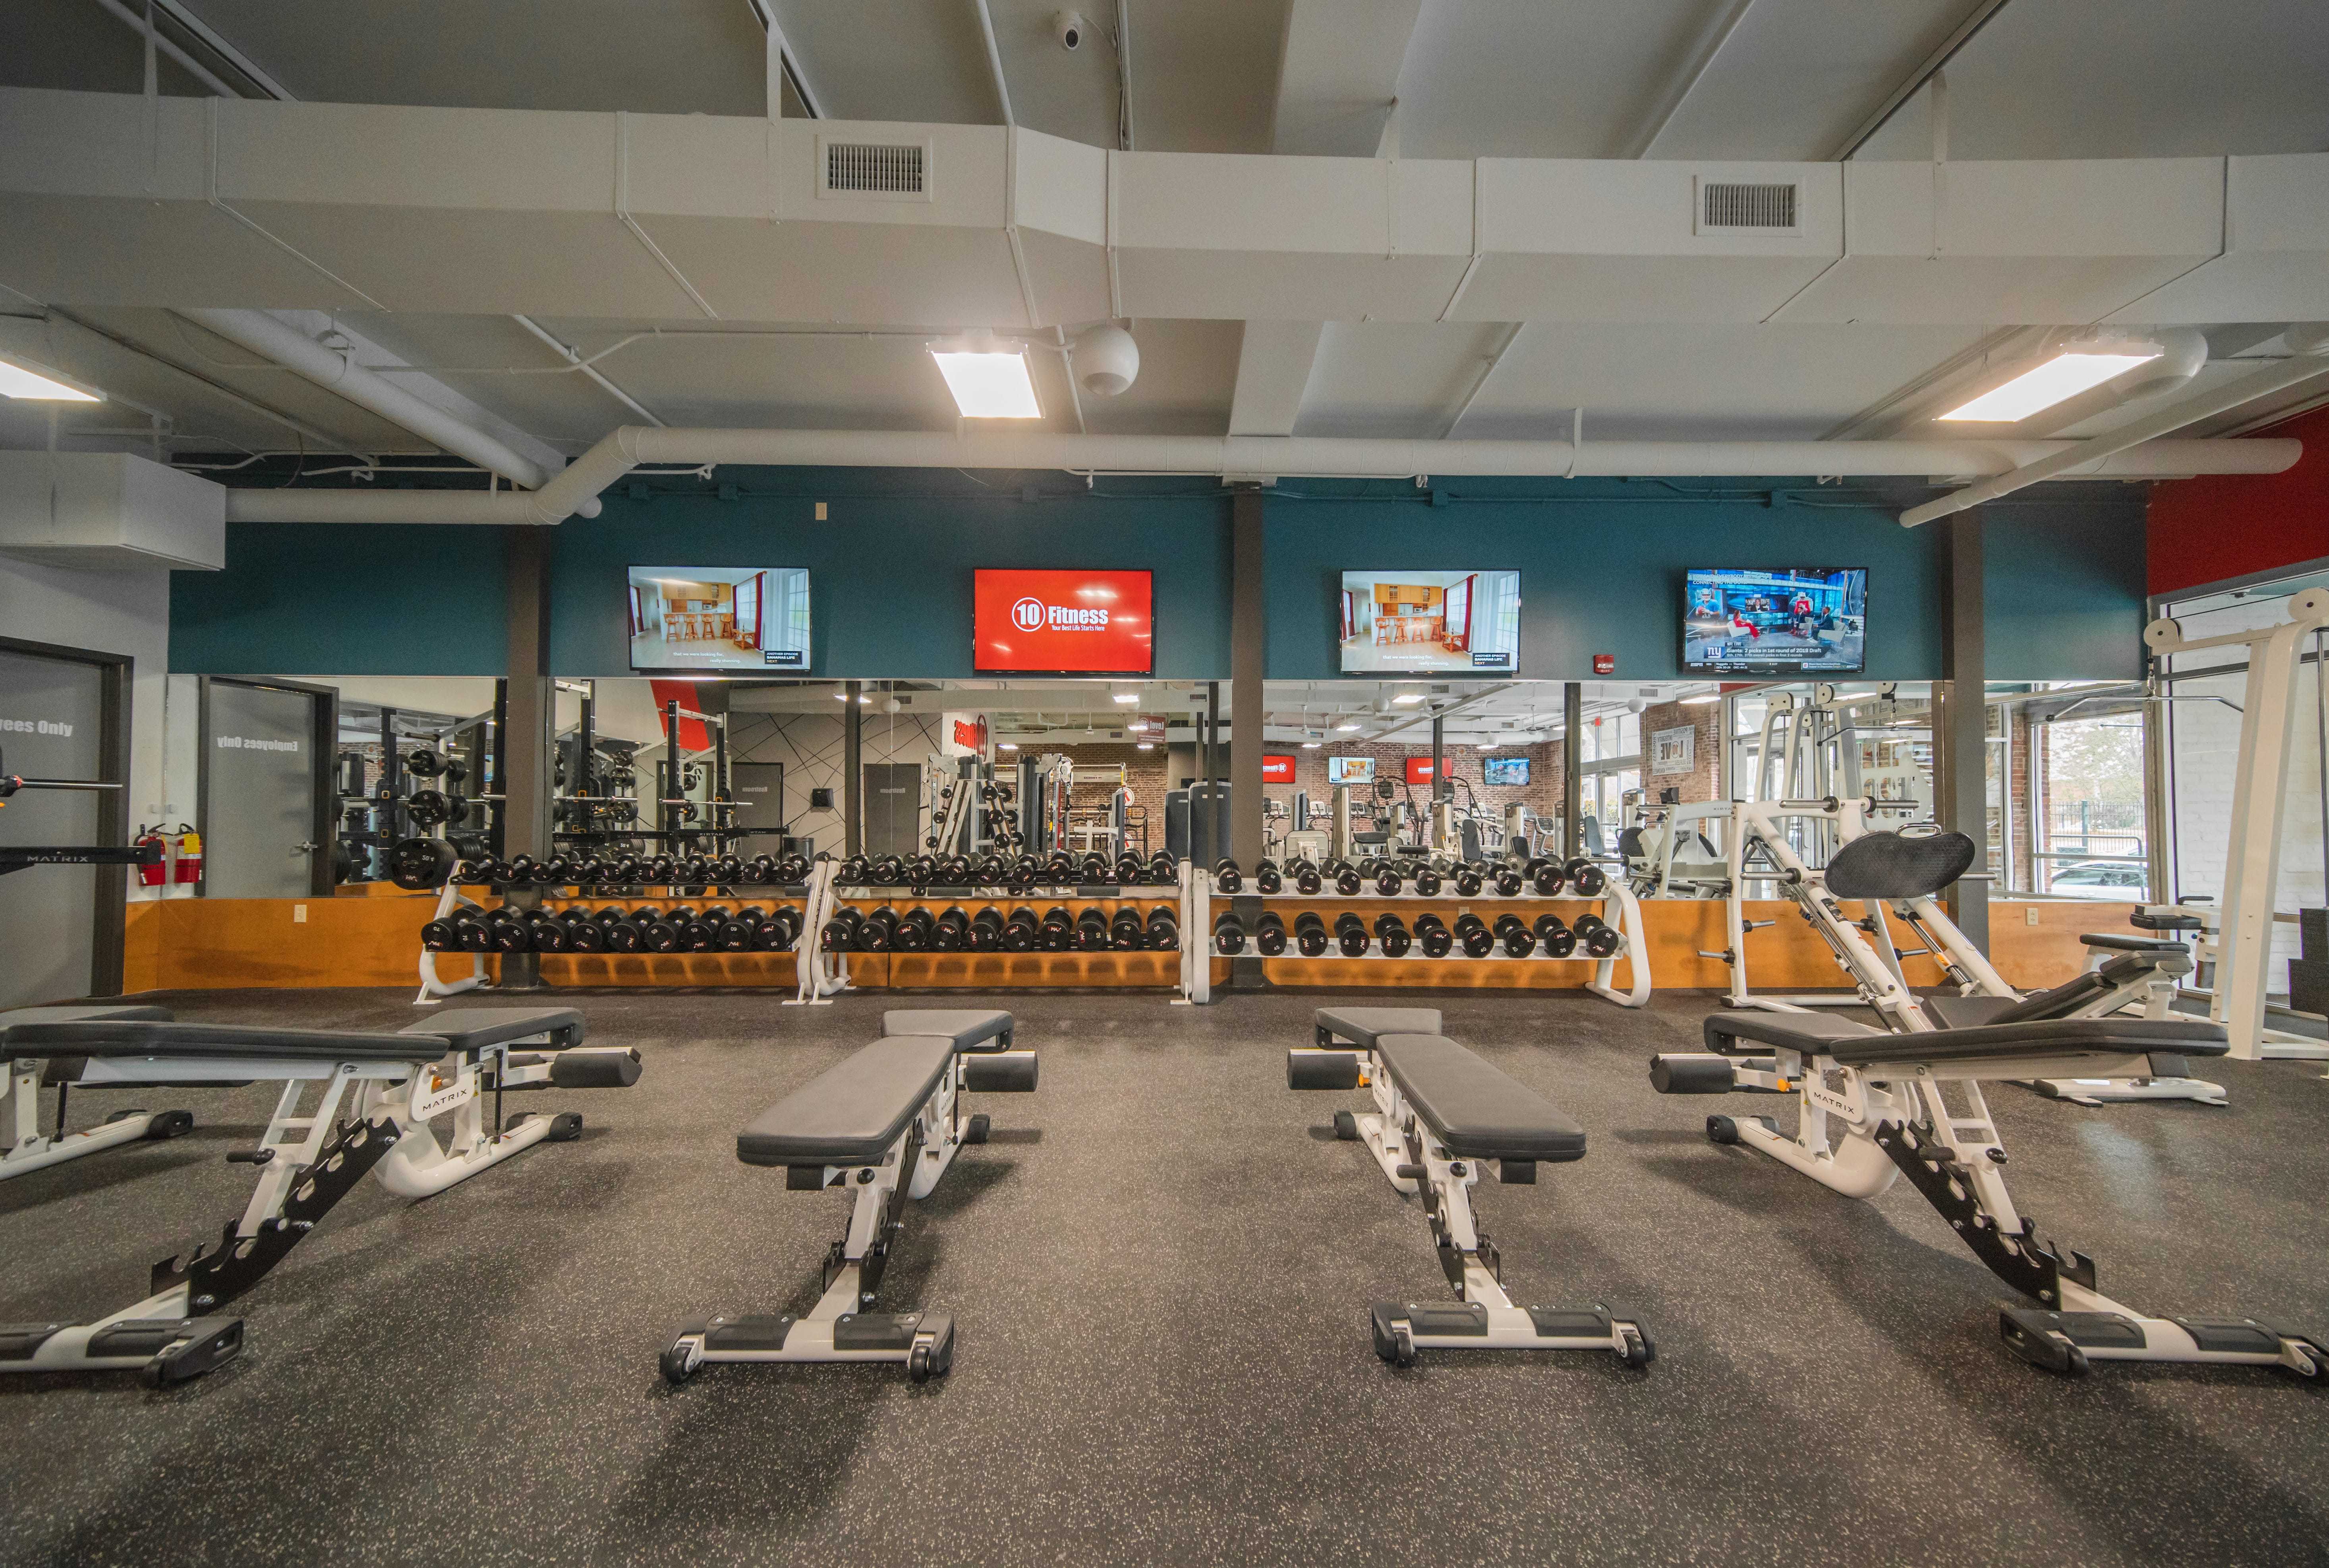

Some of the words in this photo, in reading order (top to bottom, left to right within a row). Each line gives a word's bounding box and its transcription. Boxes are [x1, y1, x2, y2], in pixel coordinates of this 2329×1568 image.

[1017, 603, 1040, 625] 10
[1048, 606, 1108, 624] Fitness
[38, 720, 73, 737] Only
[423, 1089, 467, 1111] MATRIX
[1814, 1092, 1854, 1114] MATRIX
